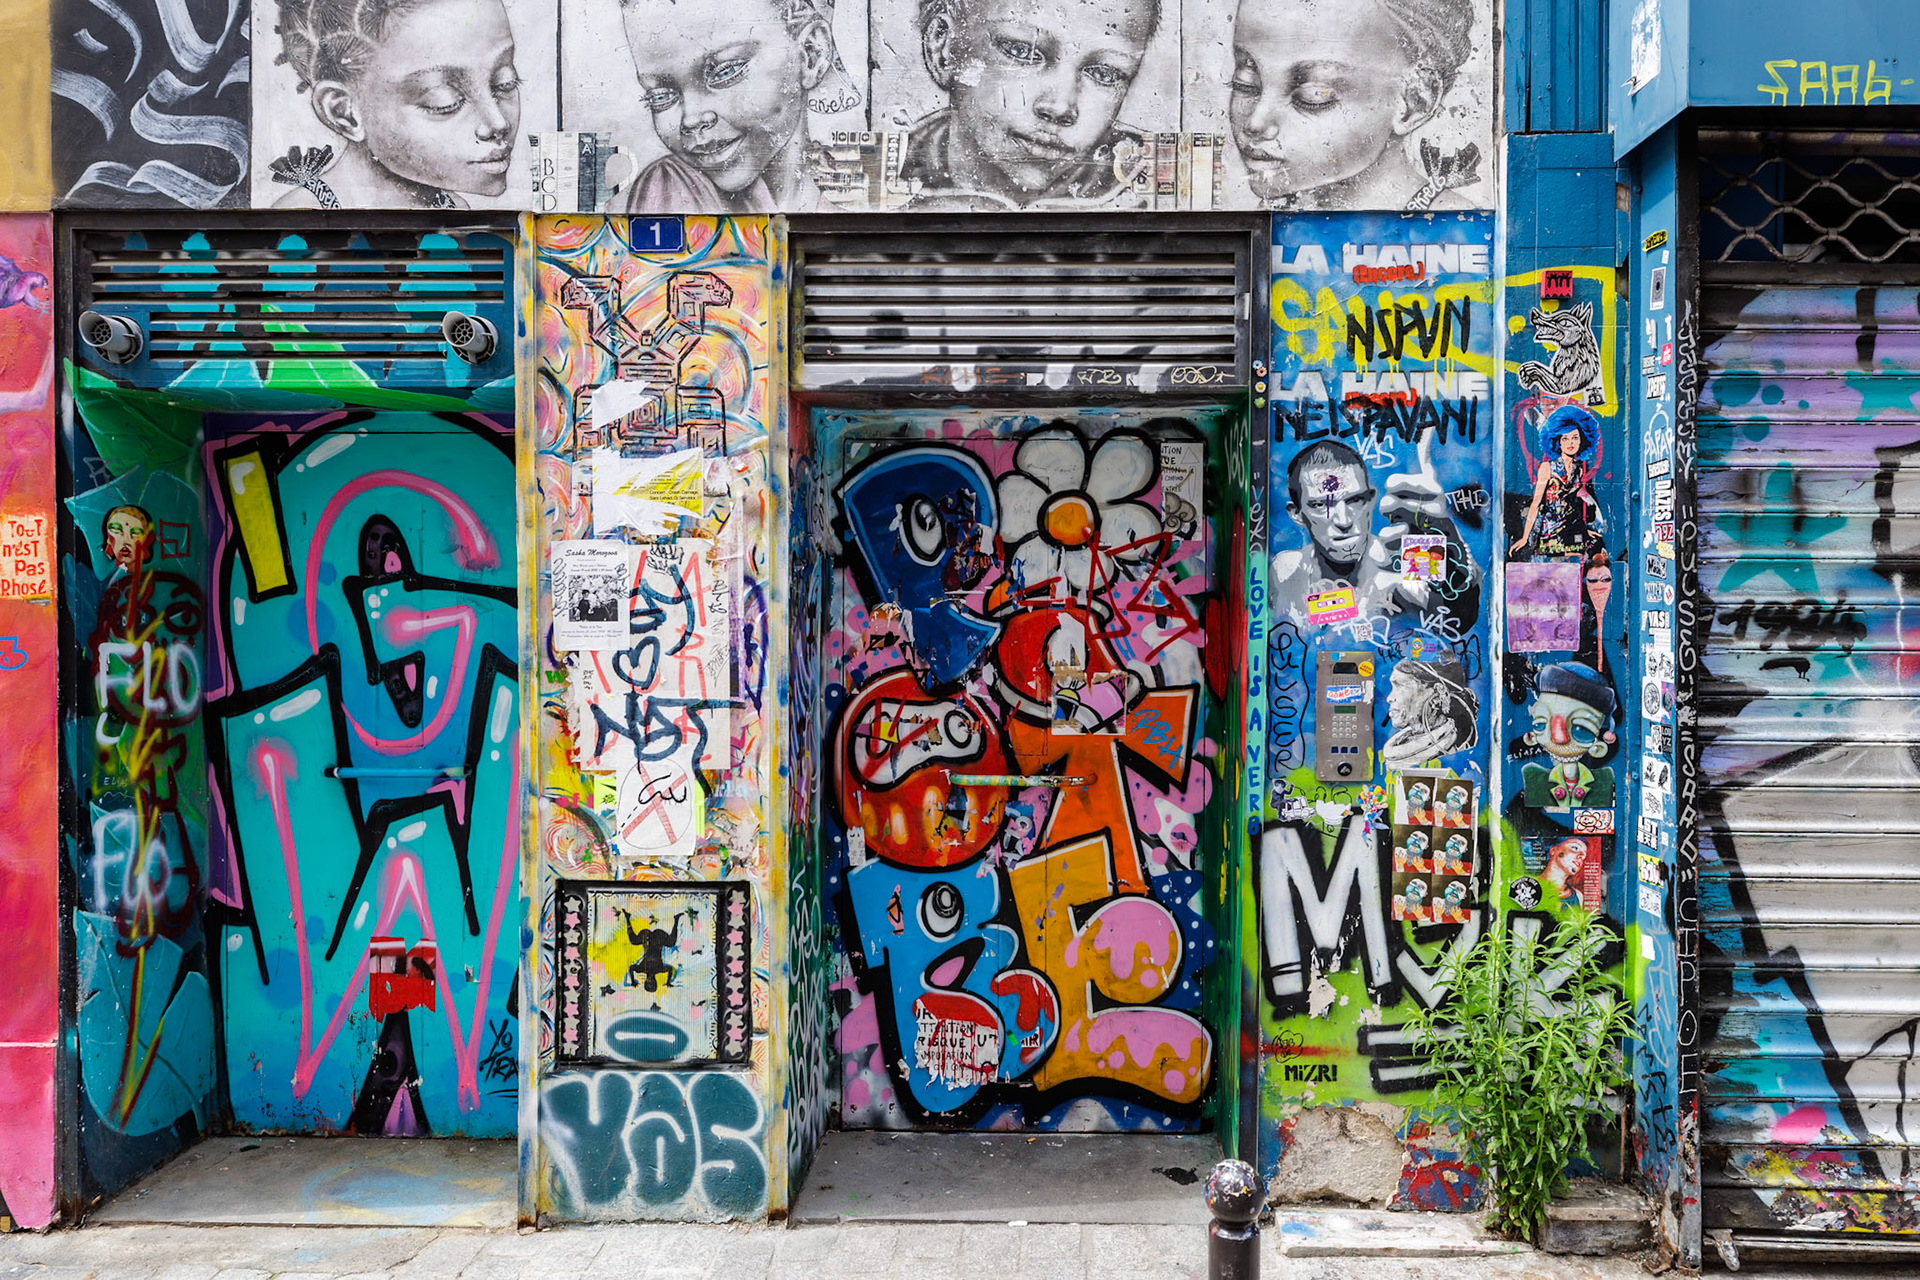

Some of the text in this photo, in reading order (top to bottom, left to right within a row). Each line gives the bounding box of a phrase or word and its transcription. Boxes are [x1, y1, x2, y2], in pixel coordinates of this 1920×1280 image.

[649, 226, 661, 246] 1
[1272, 243, 1489, 275] LA HAINE
[1271, 370, 1331, 400] LA
[1342, 370, 1489, 400] HAINE
[565, 549, 586, 557] Sasha
[1249, 567, 1265, 640] LOVE
[1250, 656, 1263, 697] IS
[1250, 708, 1262, 732] A
